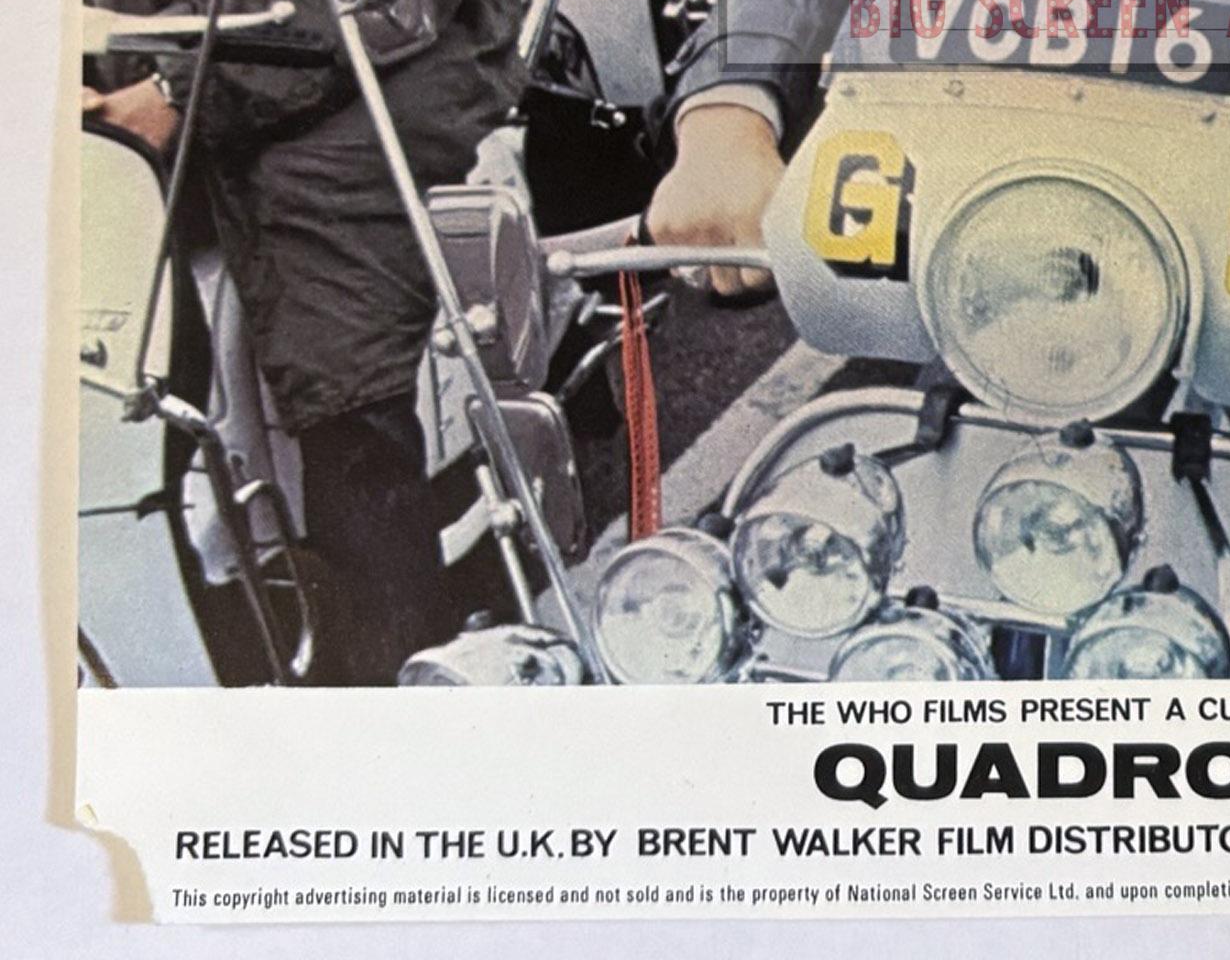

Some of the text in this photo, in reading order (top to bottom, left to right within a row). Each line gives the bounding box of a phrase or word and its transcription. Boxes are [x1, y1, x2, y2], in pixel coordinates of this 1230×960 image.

[801, 128, 913, 281] G
[764, 700, 827, 727] THE
[835, 698, 914, 726] WHO
[922, 697, 1009, 725] FILMS
[1019, 696, 1153, 724] PRESENT
[1163, 695, 1188, 723] A
[174, 828, 360, 861] RELEASED
[369, 829, 405, 861] IN
[414, 829, 487, 860] THE
[636, 826, 758, 858] BRENT
[770, 826, 923, 858] WALKER
[936, 824, 1015, 857] FILM
[171, 887, 208, 908] This
[212, 886, 290, 911] copyright
[294, 885, 388, 910] advertising
[392, 885, 463, 906] material
[466, 885, 482, 905] is
[486, 884, 555, 905] licensed
[558, 885, 590, 905] and
[594, 887, 621, 905] not
[625, 884, 660, 904] sold
[664, 884, 696, 904] and
[698, 884, 715, 904] is
[719, 883, 746, 903] the
[751, 885, 821, 907] property
[824, 882, 842, 903] of
[846, 883, 917, 903] National
[922, 882, 978, 902] Screen
[982, 881, 1044, 902] Service
[1048, 881, 1080, 901] Ltd.
[1084, 881, 1115, 901] and
[1119, 884, 1159, 904] upon
